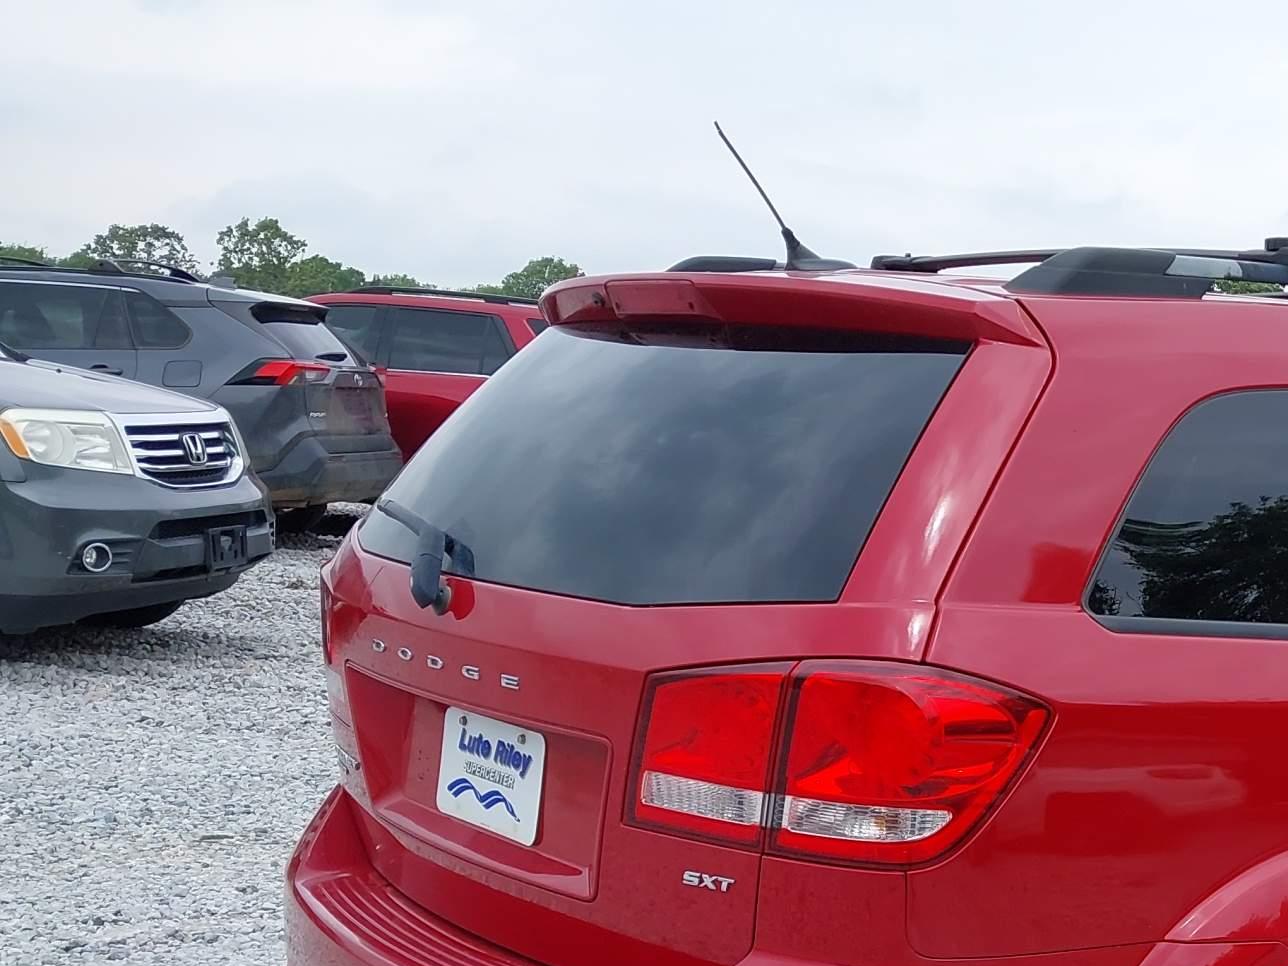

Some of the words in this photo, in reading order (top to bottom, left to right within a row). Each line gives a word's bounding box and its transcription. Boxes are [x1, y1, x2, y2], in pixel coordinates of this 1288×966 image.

[371, 638, 520, 690] DODGE
[458, 727, 492, 760] Lute
[493, 740, 533, 779] Riley
[463, 760, 516, 790] SUPERCENTER
[682, 870, 736, 893] SXT
